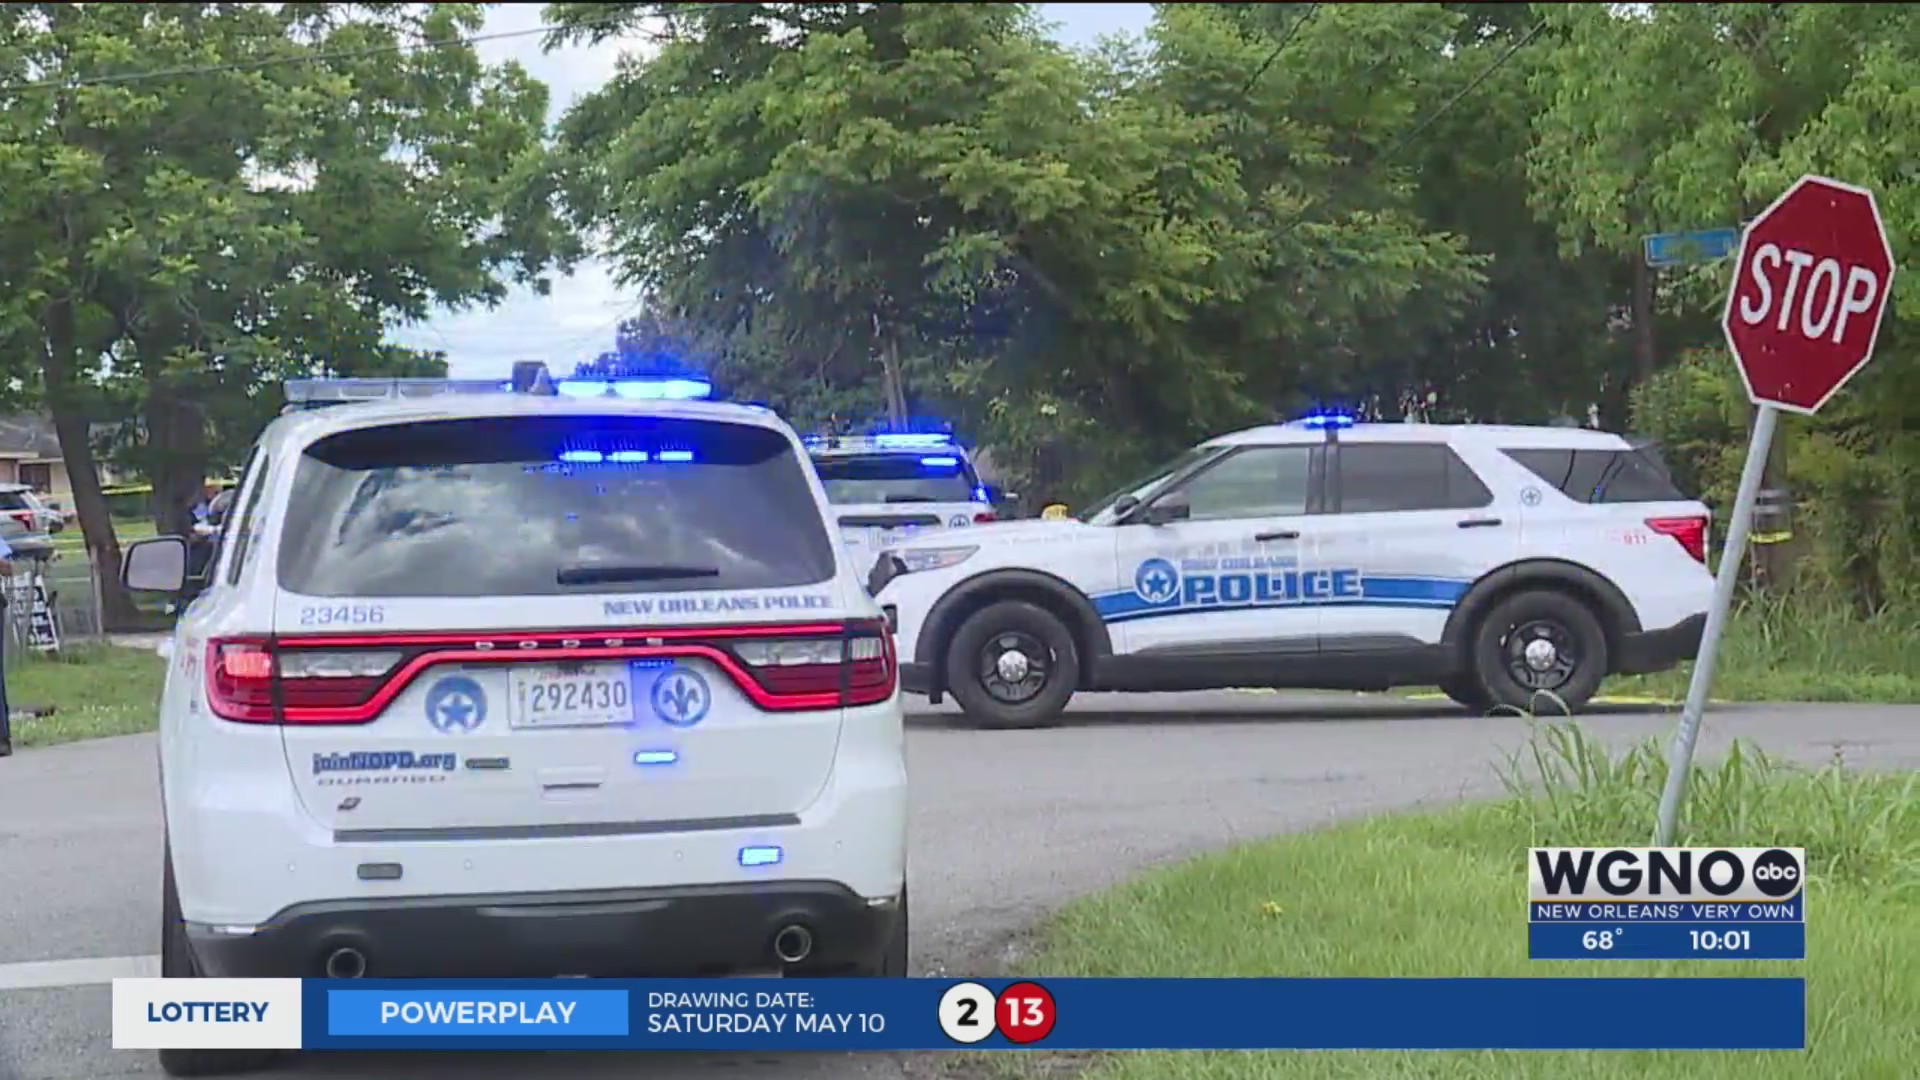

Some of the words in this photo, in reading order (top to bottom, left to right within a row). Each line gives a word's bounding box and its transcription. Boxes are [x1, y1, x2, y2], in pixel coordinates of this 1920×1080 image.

[1740, 243, 1878, 344] STOP
[1623, 534, 1647, 545] 911
[1183, 570, 1362, 604] POLICE
[300, 606, 385, 625] 23456
[604, 600, 651, 615] NEW
[659, 597, 759, 613] ORLEANS
[764, 594, 833, 609] POLICE
[531, 680, 628, 712] 292430
[313, 751, 457, 774] joinNOPD.org
